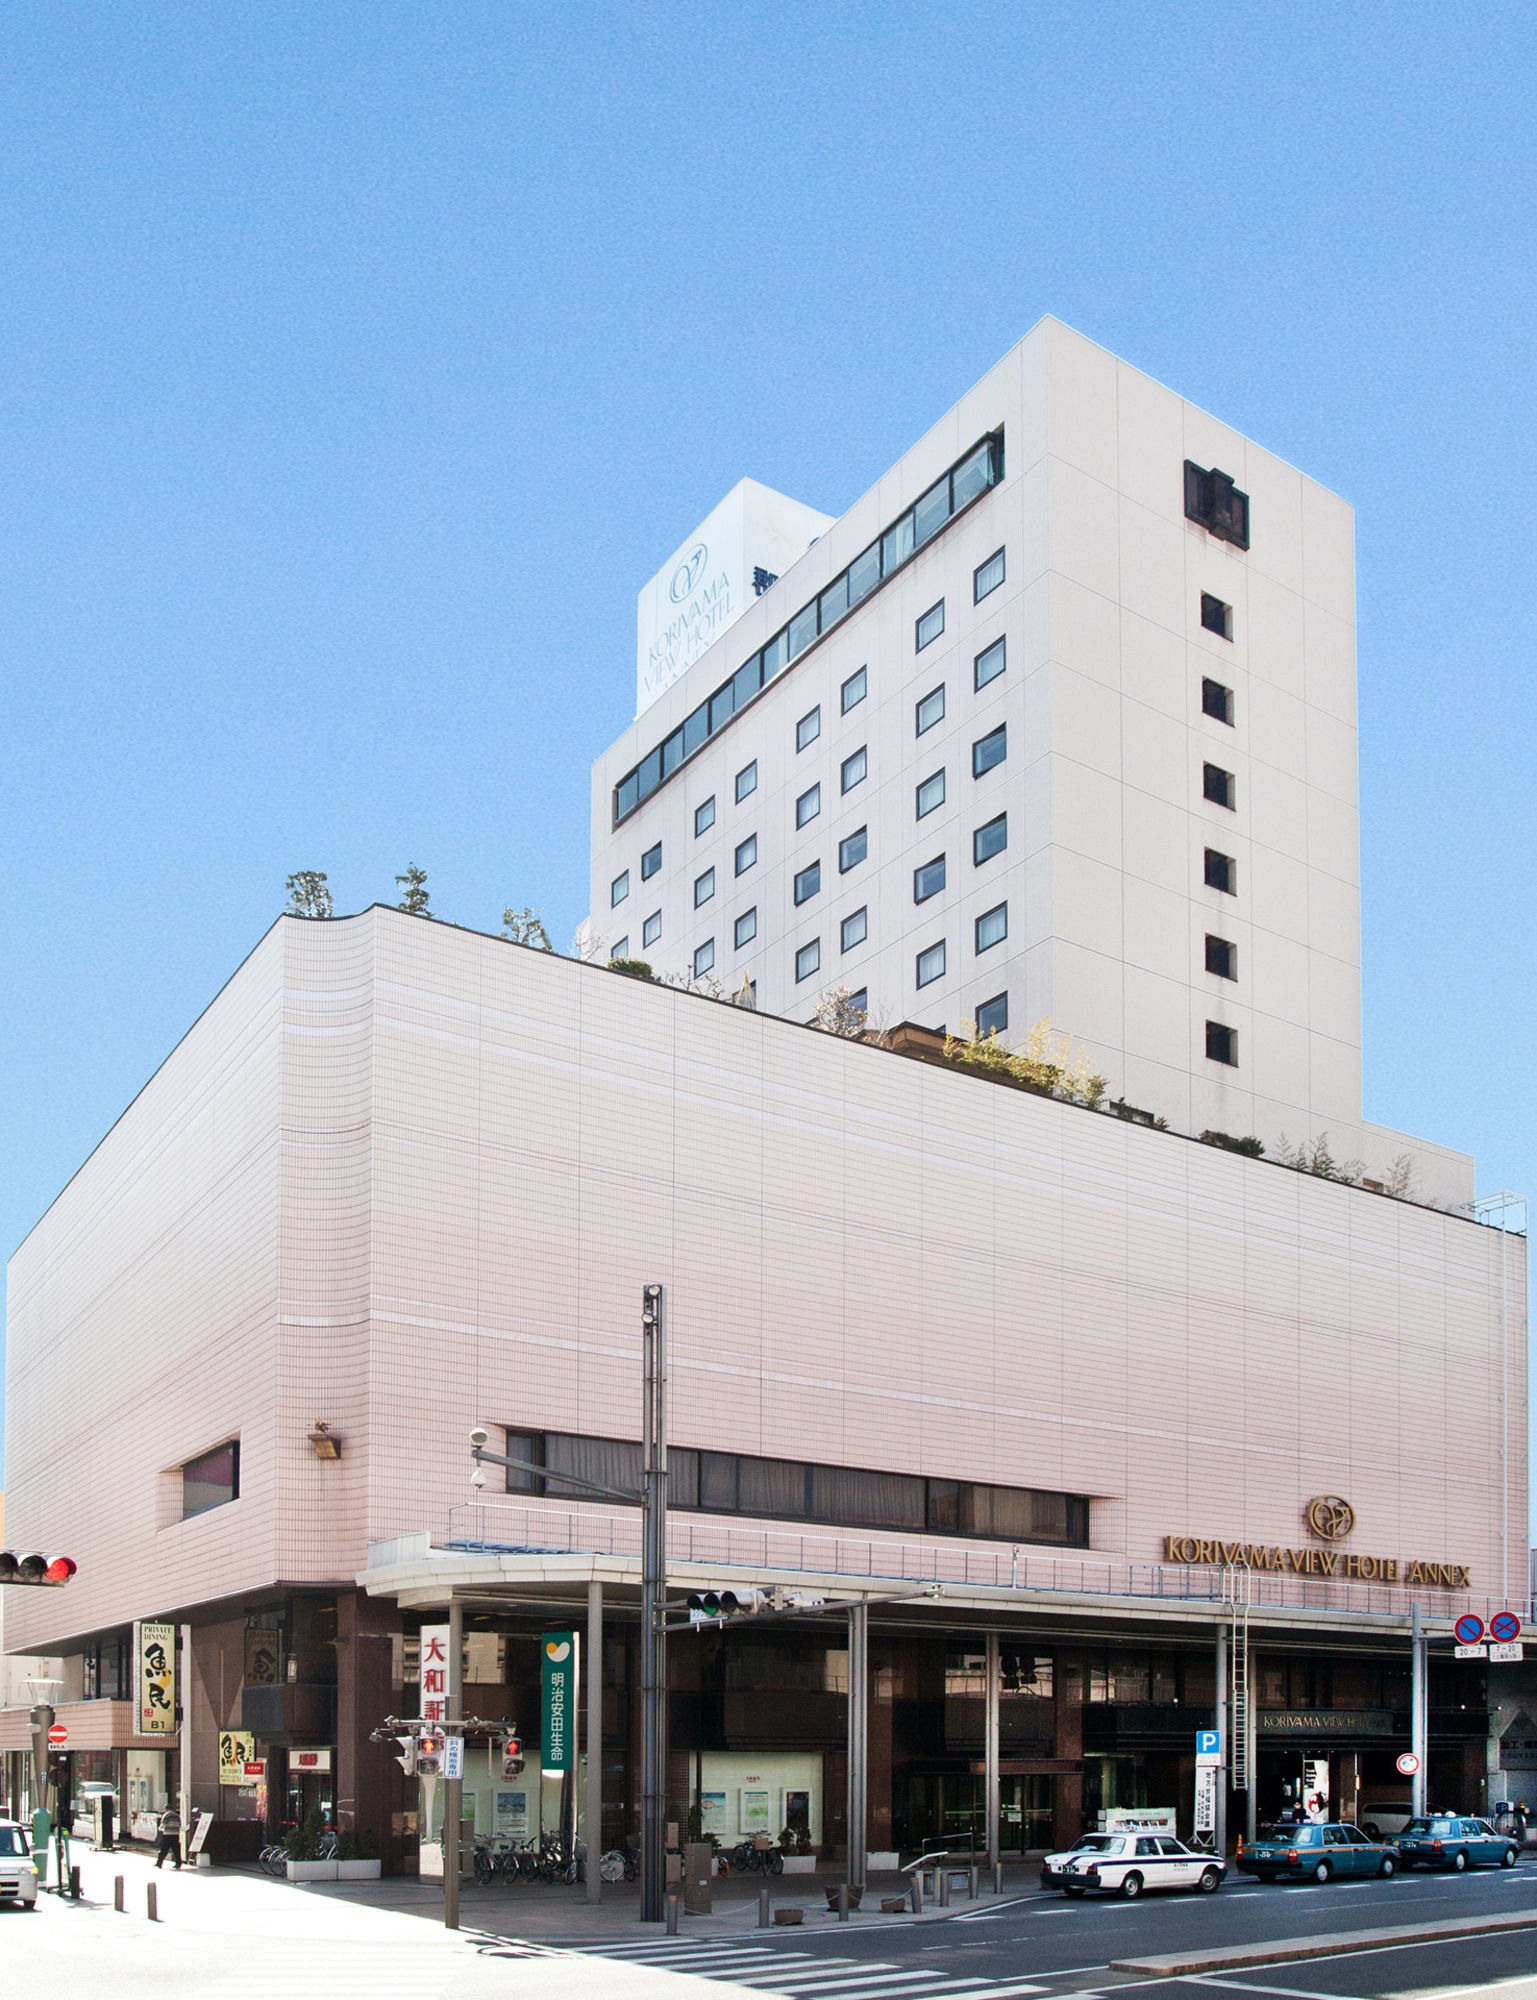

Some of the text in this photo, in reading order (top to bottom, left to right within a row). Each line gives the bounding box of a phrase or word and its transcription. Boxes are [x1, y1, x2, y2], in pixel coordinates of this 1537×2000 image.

[649, 571, 730, 668] KORIYAMA
[687, 591, 735, 655] HOTEL
[1164, 1535, 1473, 1588] KORIYAMA VIEW HOTEL ANNEX
[144, 1625, 172, 1634] PRIVATE
[144, 1633, 168, 1641] DINING
[144, 1642, 172, 1710] 魚民
[150, 1720, 166, 1729] B1
[550, 1672, 565, 1762] 明治安田生命
[1263, 1715, 1321, 1728] KORIYAMA
[1202, 1733, 1217, 1752] P
